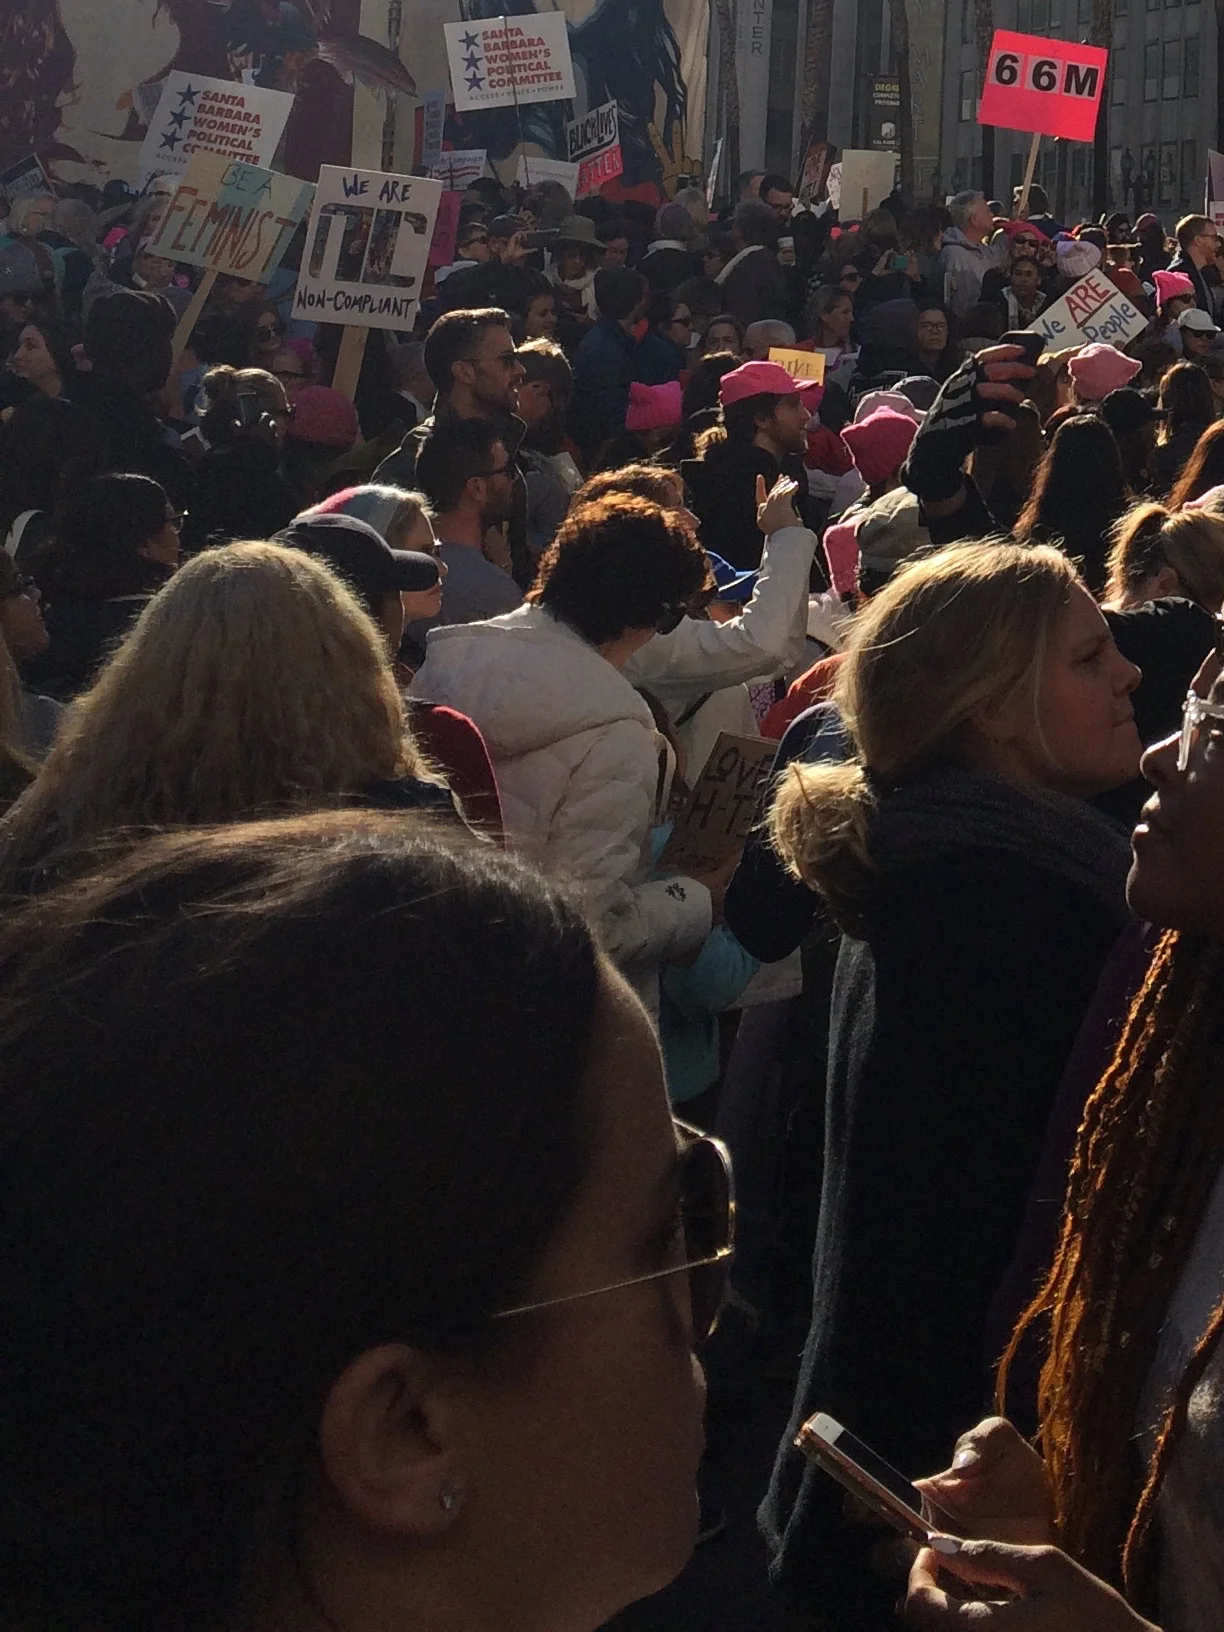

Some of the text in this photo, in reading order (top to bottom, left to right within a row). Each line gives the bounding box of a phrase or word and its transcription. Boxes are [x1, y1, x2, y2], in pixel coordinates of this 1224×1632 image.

[481, 27, 524, 40] SANTA
[483, 37, 545, 52] BARBARA
[485, 48, 551, 64] WOMEN'S
[487, 61, 551, 76] POLITICAL
[489, 71, 562, 88] COMMITTEE
[995, 53, 1099, 97] 66M
[202, 90, 245, 108] SANTA
[197, 104, 260, 125] BARBARA
[193, 116, 263, 139] WOMEN'S
[187, 129, 254, 151] POLITICAL
[220, 163, 252, 192] BE
[342, 174, 413, 203] WE ARE
[154, 186, 297, 272] FEMINIST
[297, 288, 418, 320] NON-COMPLIANT
[1065, 275, 1111, 325] ARE
[1082, 303, 1137, 343] People
